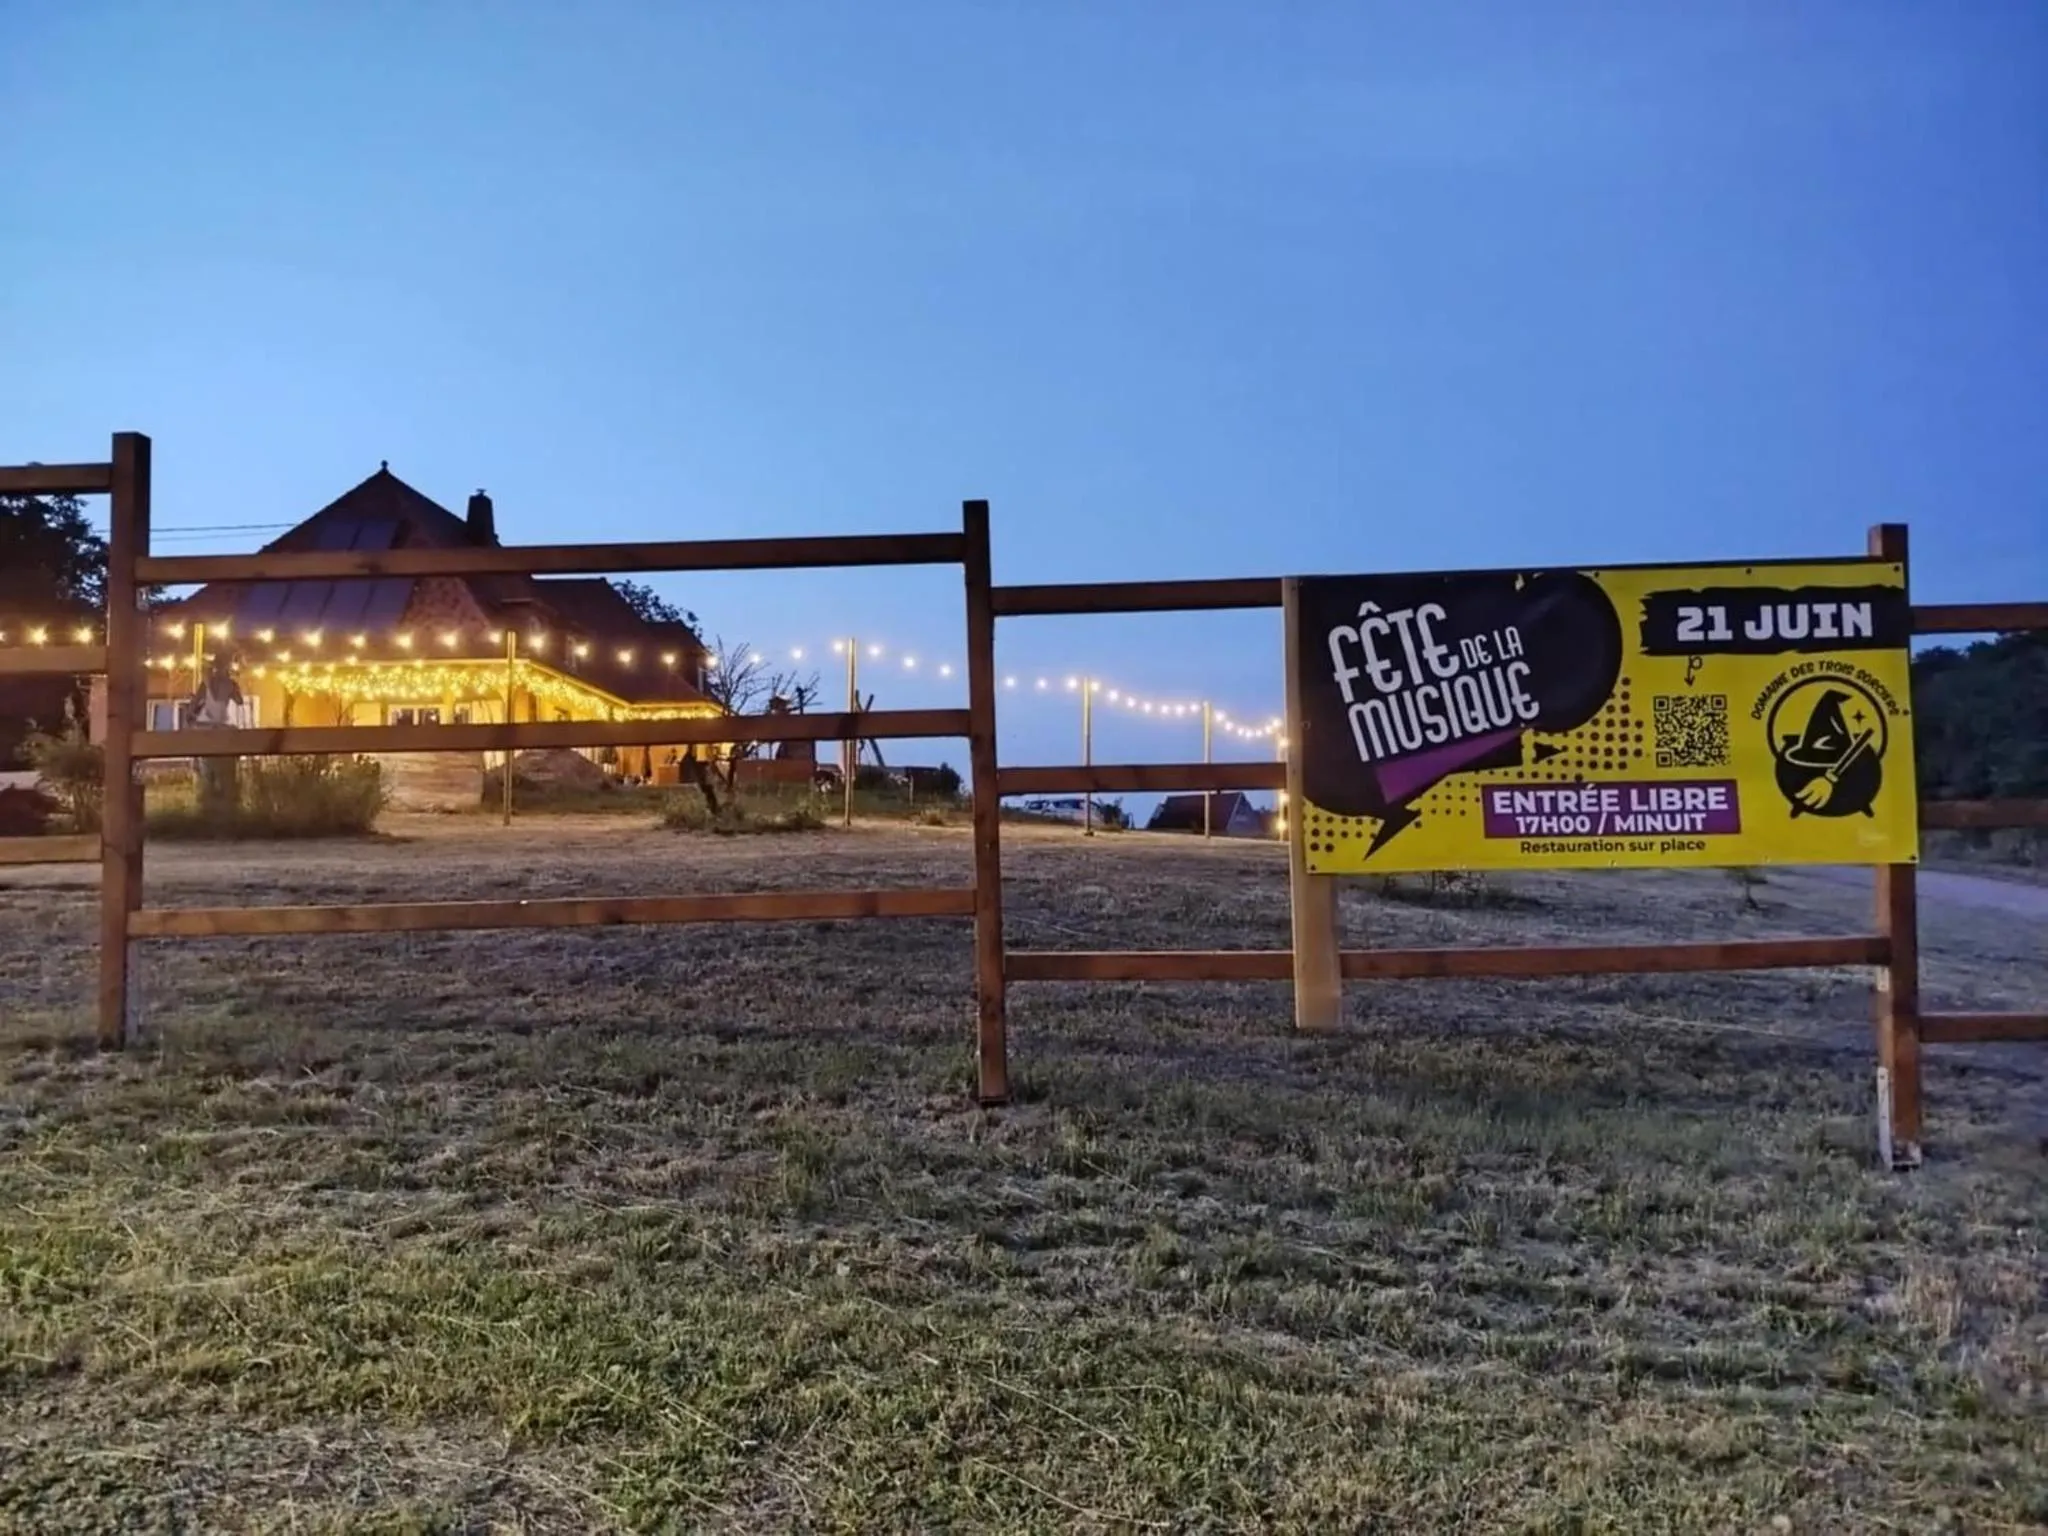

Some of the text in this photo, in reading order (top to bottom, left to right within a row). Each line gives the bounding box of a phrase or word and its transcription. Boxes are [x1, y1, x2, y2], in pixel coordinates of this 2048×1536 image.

[1677, 602, 1873, 642] 21 JUIN
[1328, 601, 1524, 703] FÊTE DE LA
[1751, 672, 1789, 720] DOMAINE
[1790, 661, 1815, 678] DES
[1818, 660, 1855, 675] TROIS
[1348, 661, 1540, 762] MUSIQUE
[1492, 783, 1729, 814] ENTRÉE LIBRE
[1515, 815, 1592, 834] 17H00
[1614, 813, 1707, 834] MINUIT
[1520, 838, 1707, 858] Restauration sur place
